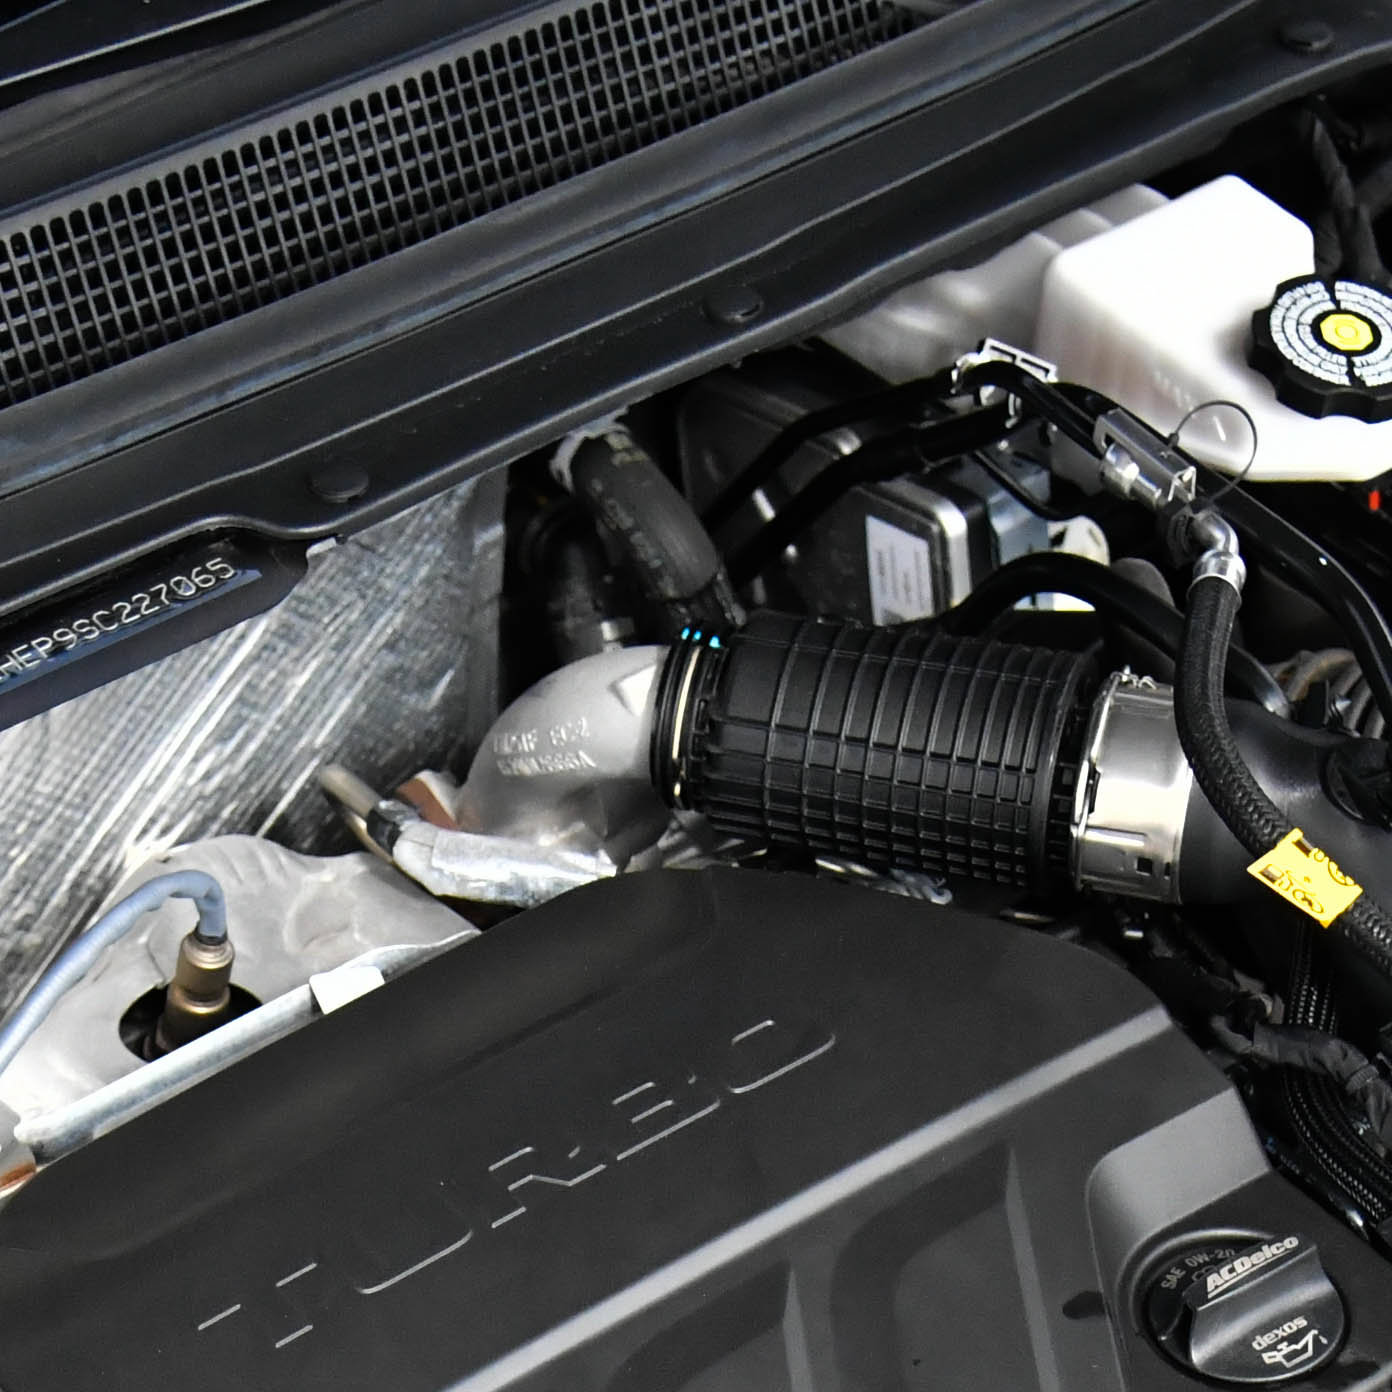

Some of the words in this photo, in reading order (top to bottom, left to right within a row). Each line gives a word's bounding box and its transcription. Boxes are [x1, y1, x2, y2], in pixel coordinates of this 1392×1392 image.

[197, 1019, 836, 1349] TURBO
[1160, 1266, 1186, 1291] SAE
[1206, 1235, 1299, 1294] ACDelco
[1251, 1316, 1308, 1351] dexos
